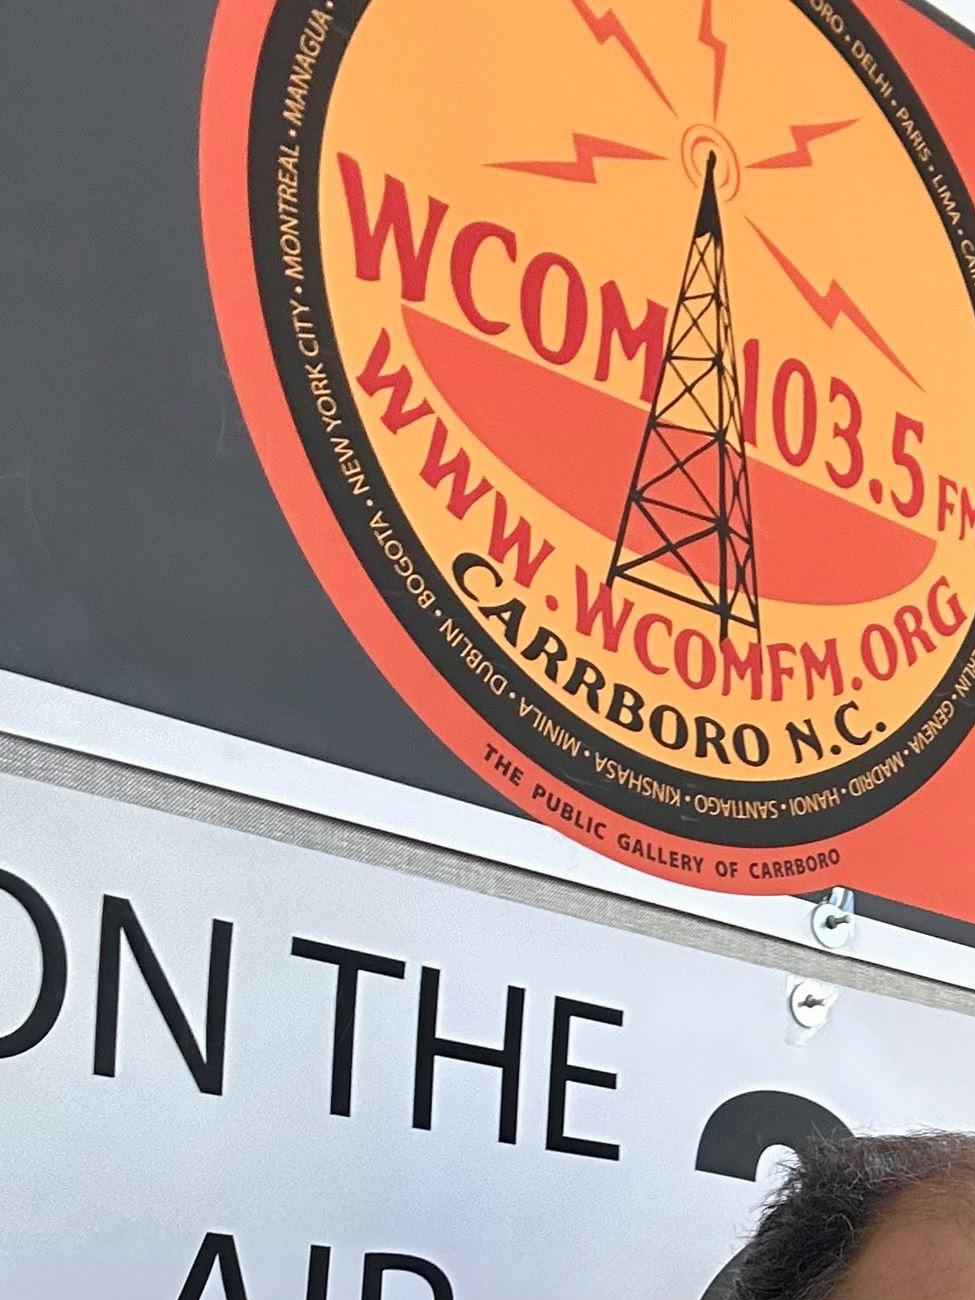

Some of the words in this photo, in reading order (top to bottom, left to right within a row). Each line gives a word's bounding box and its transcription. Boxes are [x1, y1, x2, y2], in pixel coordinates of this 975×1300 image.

[282, 8, 333, 126] MANAGUA
[851, 39, 894, 98] DELHI
[895, 106, 932, 162] PARIS
[276, 144, 305, 280] MONTREAL
[931, 174, 961, 225] LIMA
[289, 299, 320, 357] CITY
[337, 151, 669, 404] WCOM
[742, 337, 925, 518] 103.5
[304, 362, 342, 433] YORK
[330, 437, 371, 495] NEW
[355, 327, 968, 702] WWW.WCOMFM.ORG
[368, 510, 436, 609] BOGOTA
[439, 618, 508, 696] DUBLIN
[451, 551, 770, 767] CARRBORO
[785, 700, 888, 765] N.C.
[518, 696, 582, 757] MINILA
[907, 700, 955, 754] GENEVA
[594, 751, 681, 807] KINSHASA
[789, 787, 841, 816] HANOI
[848, 751, 905, 797] MADRID
[483, 743, 524, 787] THE
[531, 783, 607, 840] PUBLIC
[617, 833, 704, 873] GALLERY
[714, 860, 739, 878] OF
[749, 848, 841, 880] CARRBORO
[694, 794, 779, 820] SANTIAGO
[290, 936, 625, 1163] THE
